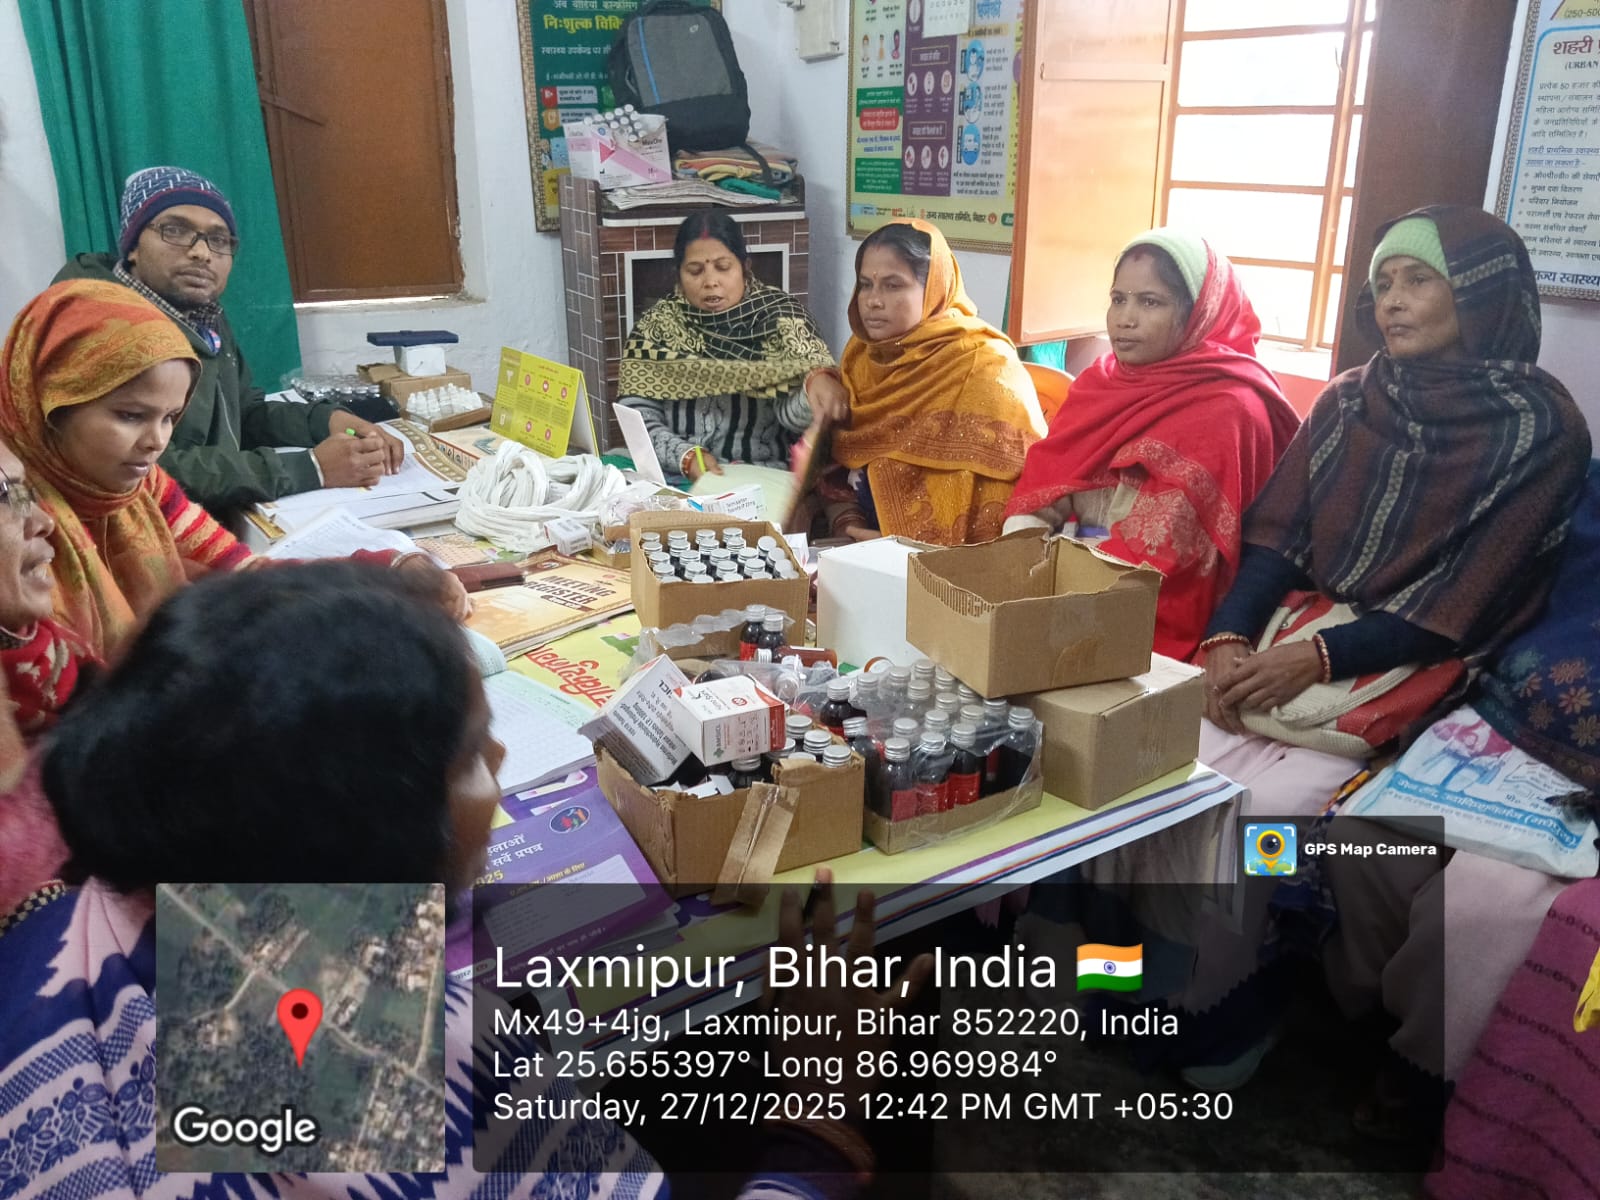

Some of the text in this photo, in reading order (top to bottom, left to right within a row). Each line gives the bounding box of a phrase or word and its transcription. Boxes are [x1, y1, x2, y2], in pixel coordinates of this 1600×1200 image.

[543, 14, 593, 34] निःशुल्क
[1552, 34, 1595, 55] शहरी
[1564, 60, 1598, 71] (URBAN
[1534, 270, 1558, 283] ाज्य
[524, 580, 599, 606] REGISTER
[540, 575, 617, 598] MEETING
[487, 834, 526, 857] लाओं
[515, 842, 543, 859] प्रपत्र
[475, 868, 504, 887] 025
